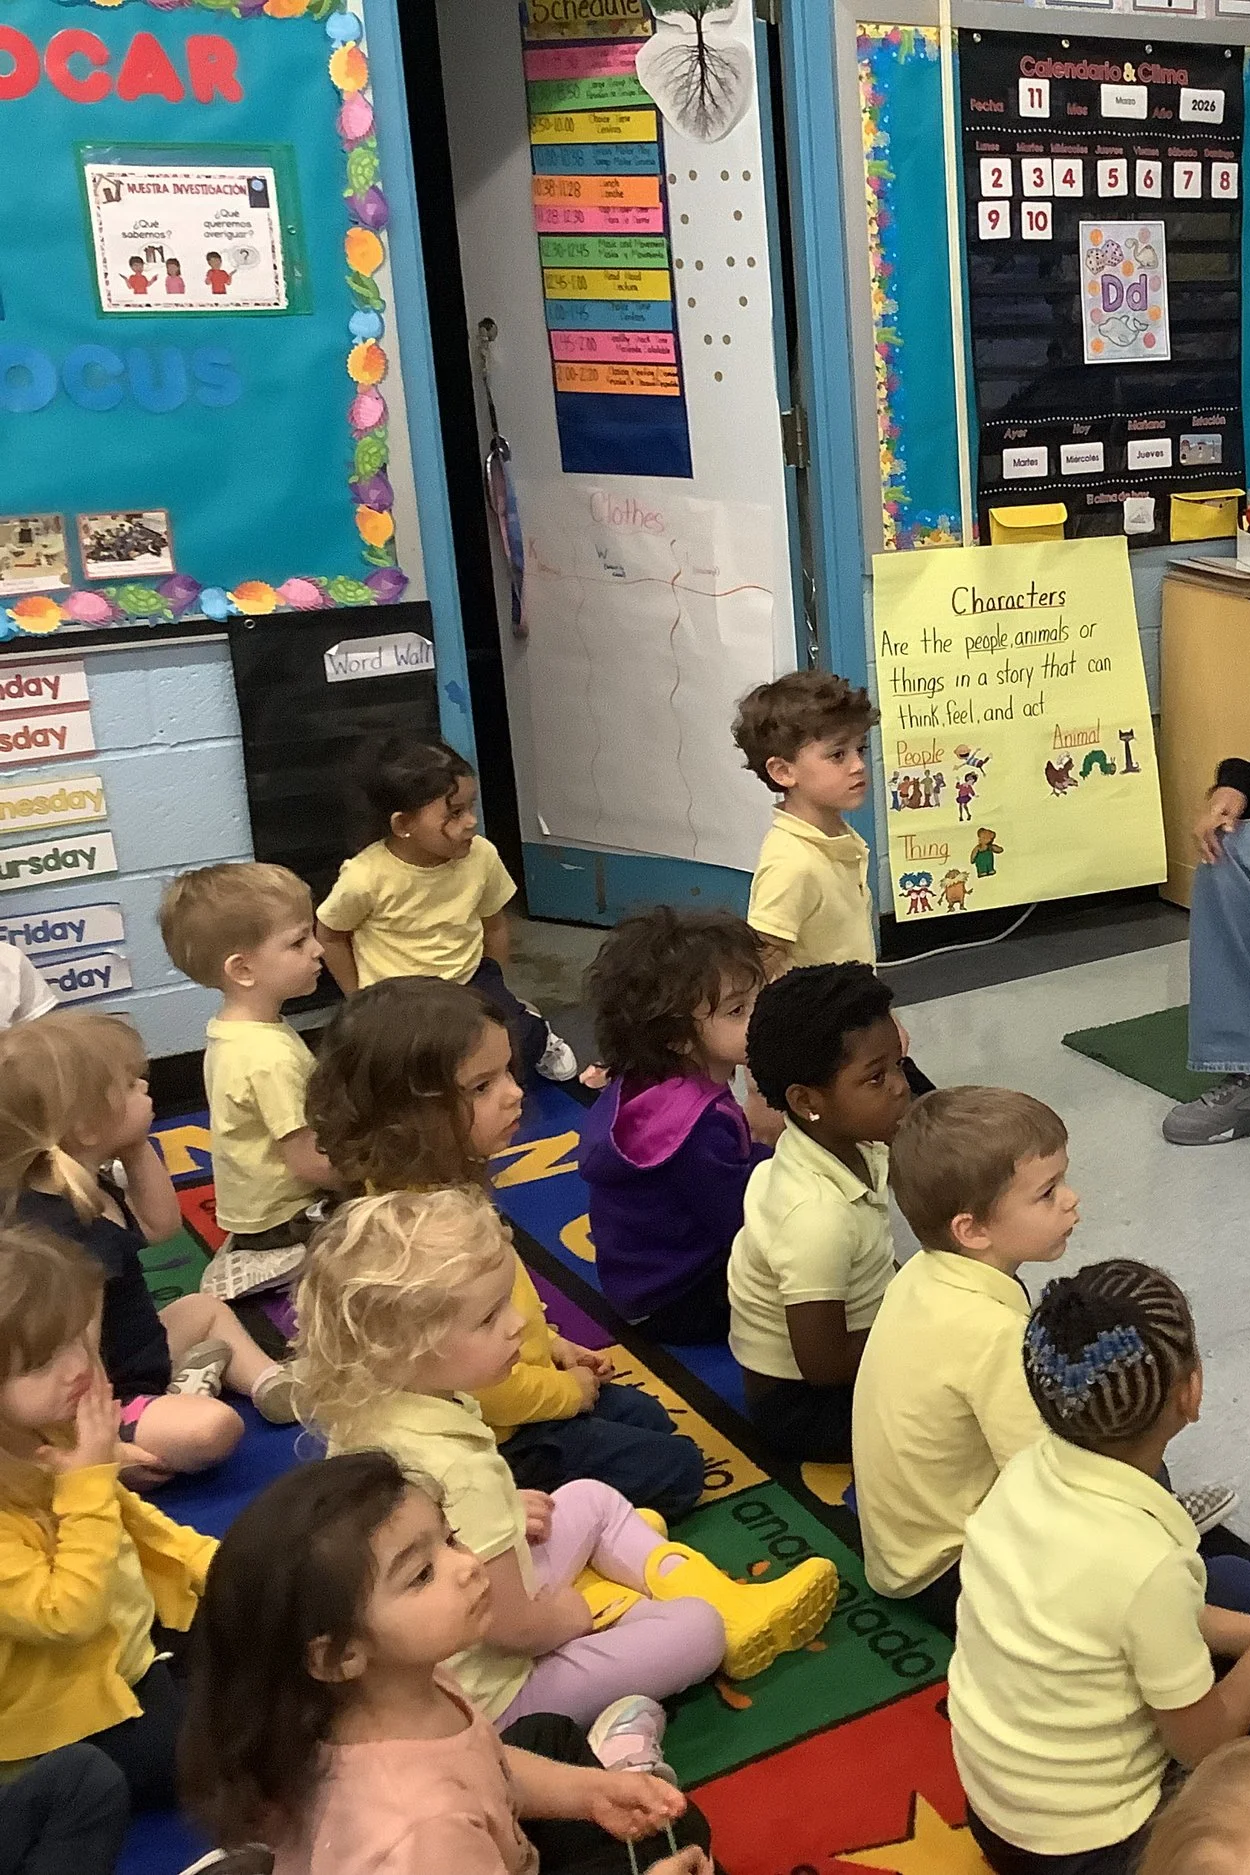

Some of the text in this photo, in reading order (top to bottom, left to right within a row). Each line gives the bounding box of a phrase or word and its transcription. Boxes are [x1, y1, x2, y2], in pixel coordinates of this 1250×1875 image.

[532, 0, 640, 23] Schedule
[1020, 55, 1189, 85] Calendario & Clima
[970, 98, 1005, 113] Fecha
[1027, 87, 1043, 109] 11
[1191, 99, 1216, 112] 2026
[991, 167, 1003, 188] 2
[1032, 167, 1044, 188] 3
[1062, 167, 1075, 188] 4
[1107, 167, 1119, 188] 5
[1143, 169, 1154, 189] 6
[1182, 170, 1193, 190] 7
[1219, 170, 1231, 191] 8
[127, 183, 248, 195] NUESTRA INVESTIGACIÓN
[133, 219, 159, 230] ¿Qué
[204, 220, 252, 229] queremos
[214, 209, 240, 220] ¿Qué
[987, 209, 1000, 230] 9
[1026, 210, 1048, 231] 10
[122, 230, 172, 239] sabemos?
[204, 230, 253, 240] averiguar?
[1101, 273, 1148, 313] Dd
[1003, 427, 1028, 440] Ayer
[1072, 423, 1091, 436] Hoy
[1013, 458, 1038, 467] Martes
[1136, 450, 1164, 459] Jueves
[590, 492, 664, 533] Clothes
[951, 581, 1066, 614] Characters
[881, 630, 909, 657] Are
[920, 626, 952, 654] the
[1015, 615, 1069, 645] animals
[1079, 623, 1097, 638] or
[329, 641, 430, 674] Word Wall
[889, 649, 1112, 698] things in a story that can
[983, 694, 1014, 722] and
[1022, 690, 1045, 717] act
[1053, 718, 1100, 749] Animal
[896, 737, 945, 768] People
[897, 834, 949, 863] Thing
